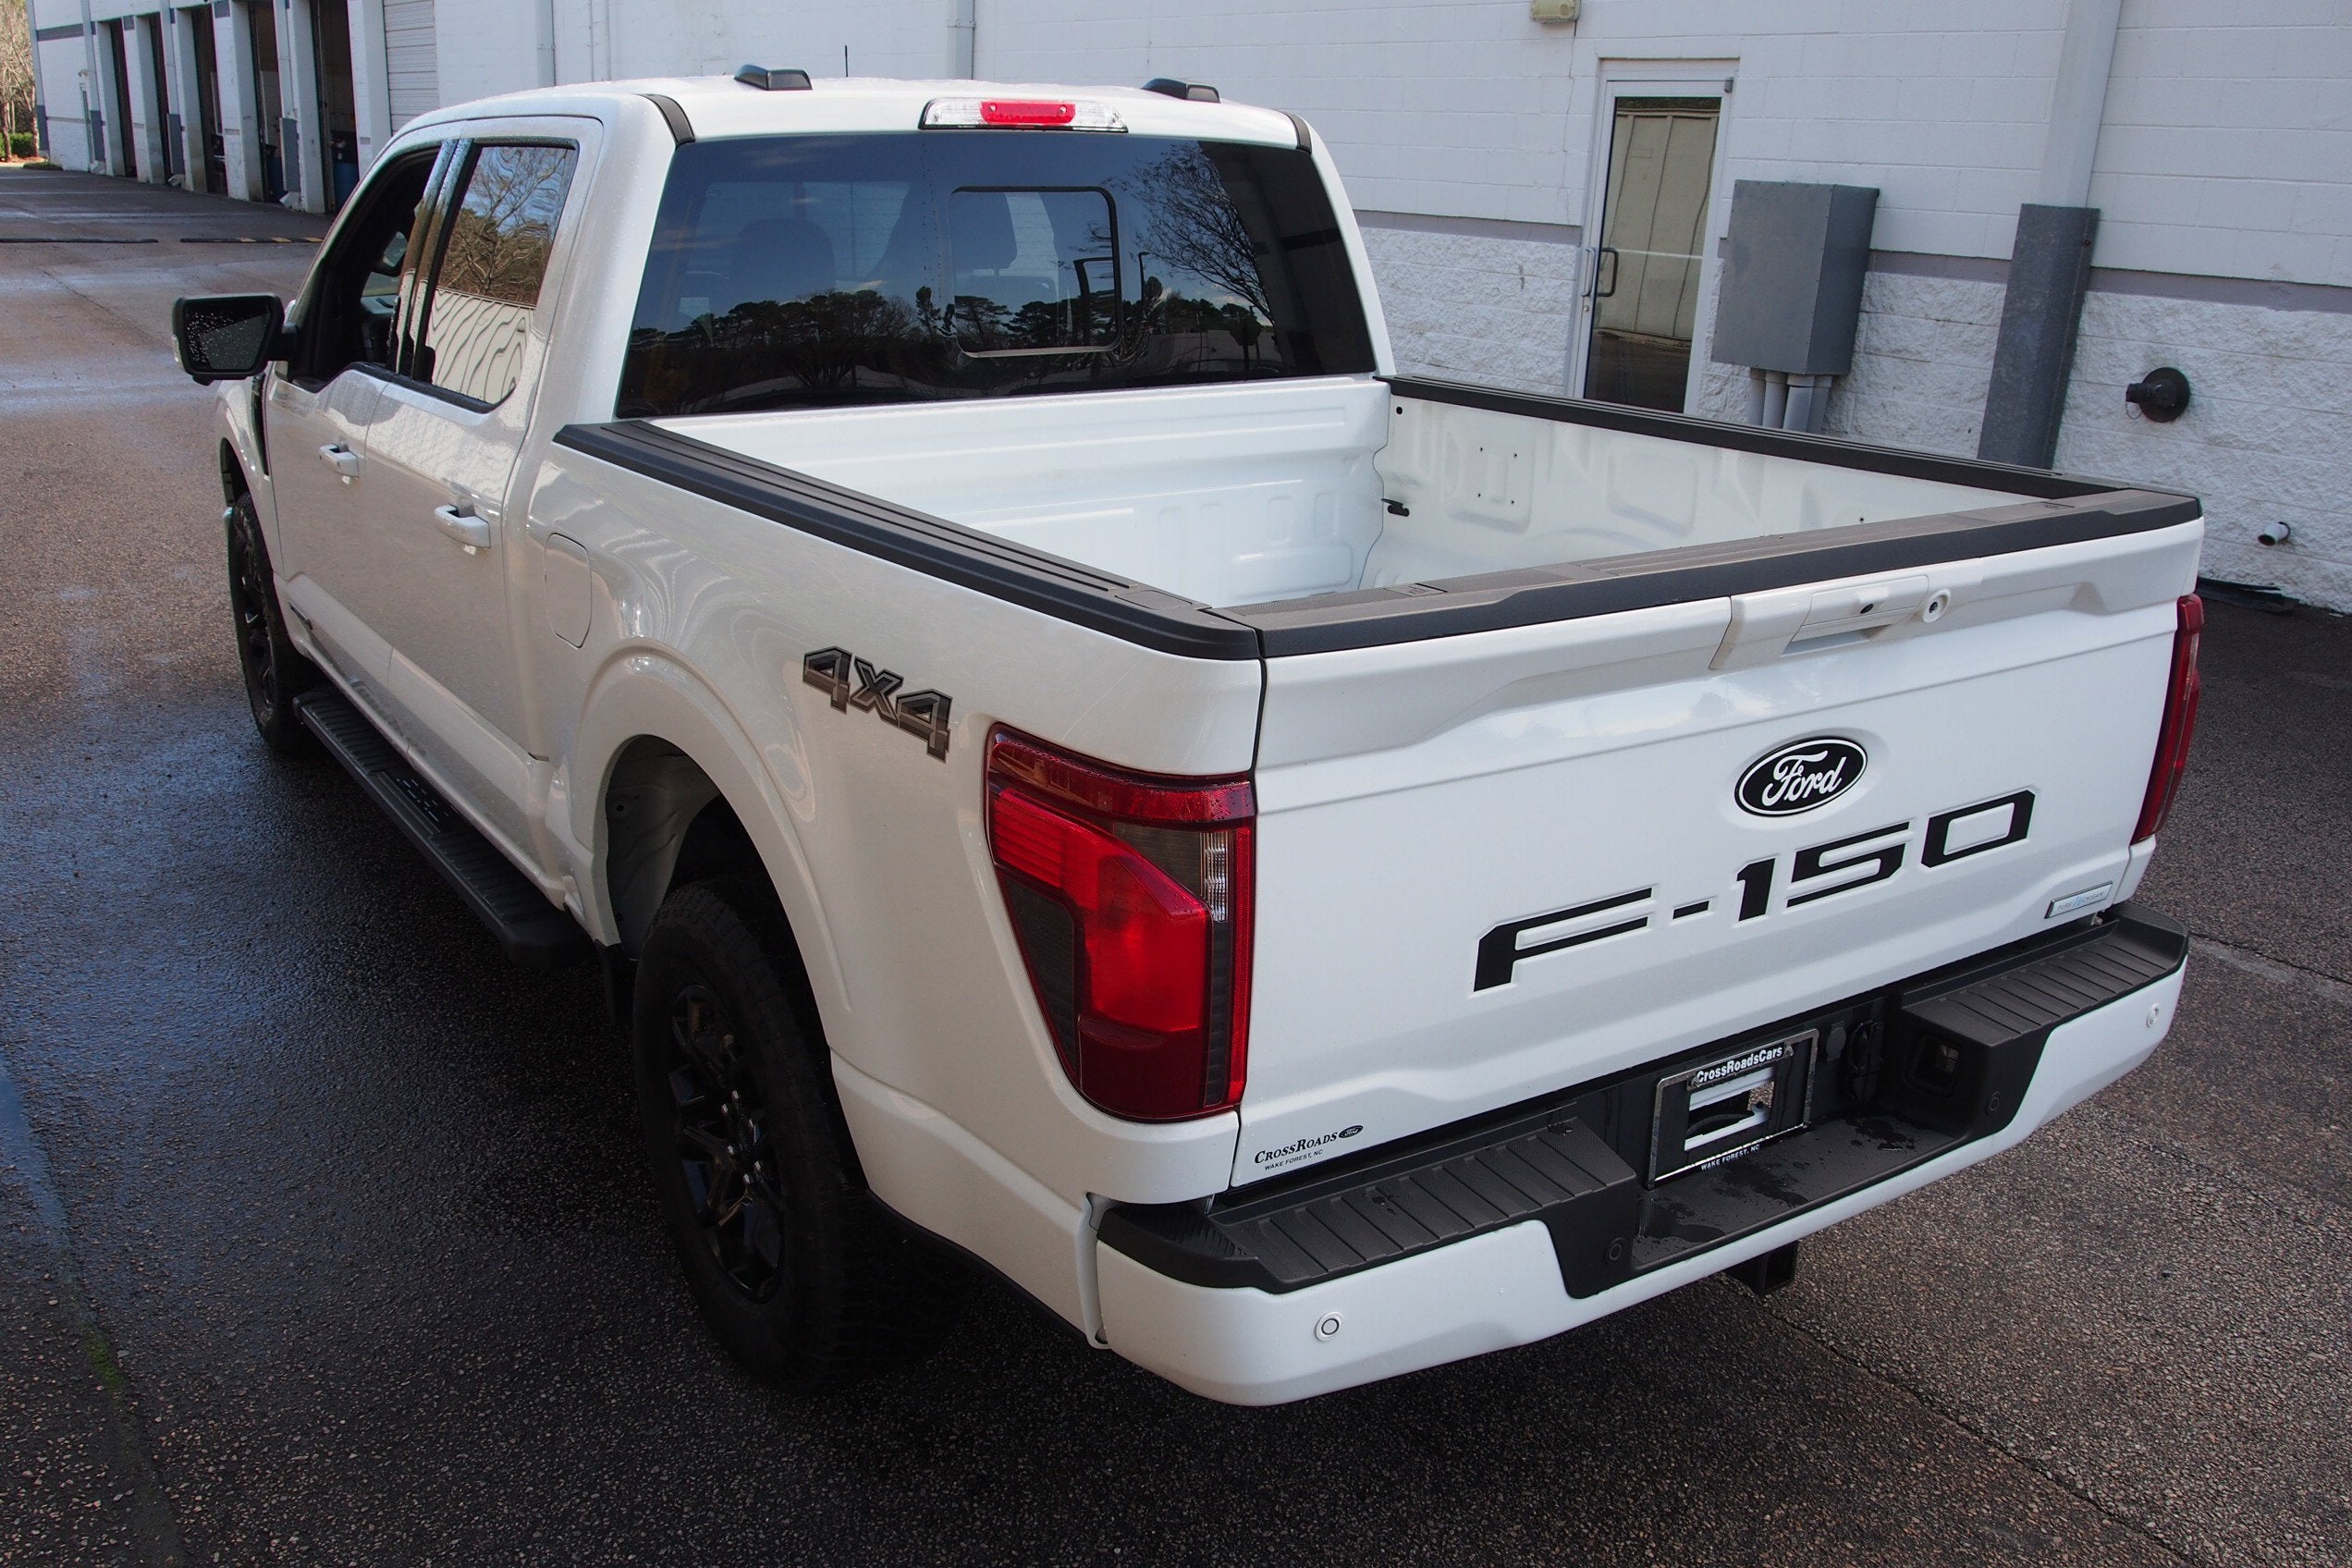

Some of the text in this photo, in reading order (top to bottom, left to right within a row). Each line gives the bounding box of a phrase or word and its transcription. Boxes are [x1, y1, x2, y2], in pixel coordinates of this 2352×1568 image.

[1760, 749, 1848, 806] Ford
[1473, 789, 2037, 993] F-150
[1696, 1046, 1783, 1084] CrossRoadsCars
[1265, 1161, 1284, 1171] WAKE
[1313, 1149, 1324, 1158] NC
[1700, 1158, 1721, 1171] WAKE
[1750, 1144, 1760, 1156] NC
